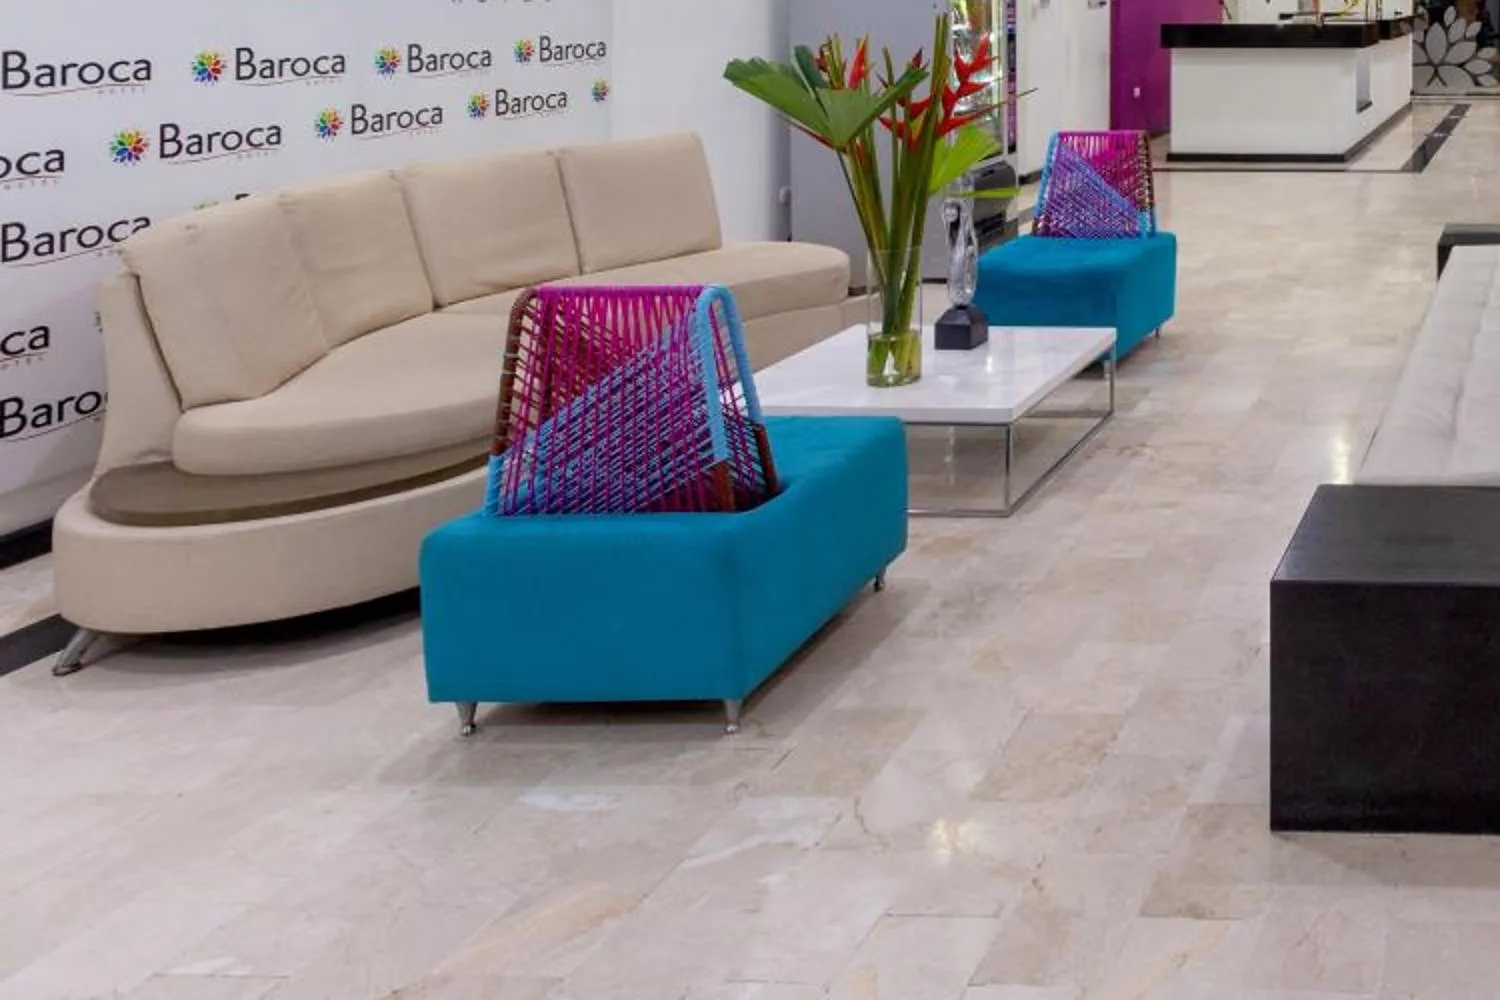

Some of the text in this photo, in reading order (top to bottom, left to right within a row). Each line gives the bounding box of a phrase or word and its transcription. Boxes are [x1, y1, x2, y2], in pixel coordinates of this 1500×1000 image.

[235, 47, 345, 81] Baroca
[408, 44, 492, 73] Baroca
[540, 36, 606, 62] Baroca
[2, 50, 152, 90] Baroca
[495, 89, 567, 117] Baroca
[351, 104, 443, 135] Baroca
[159, 123, 281, 159] Baroca
[0, 391, 108, 438] Baro
